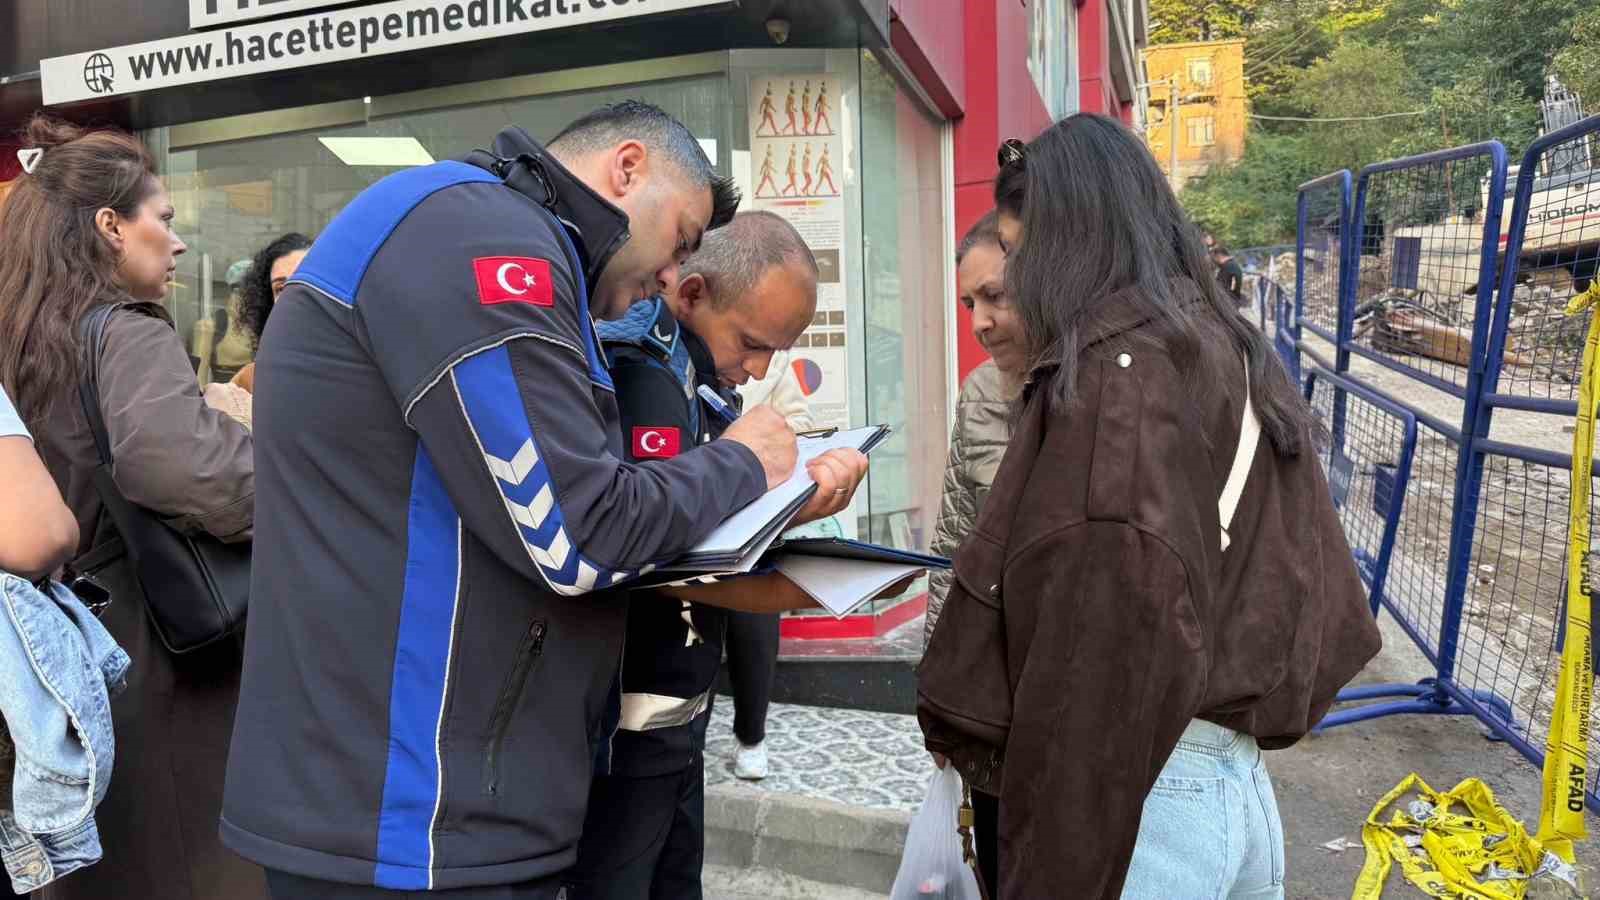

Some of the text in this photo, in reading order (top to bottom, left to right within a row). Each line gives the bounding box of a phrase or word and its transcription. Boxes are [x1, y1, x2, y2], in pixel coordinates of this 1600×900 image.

[128, 0, 646, 81] www.hacettepemedikat.
[1578, 686, 1591, 743] KURTARMA
[1568, 763, 1585, 812] AFAD
